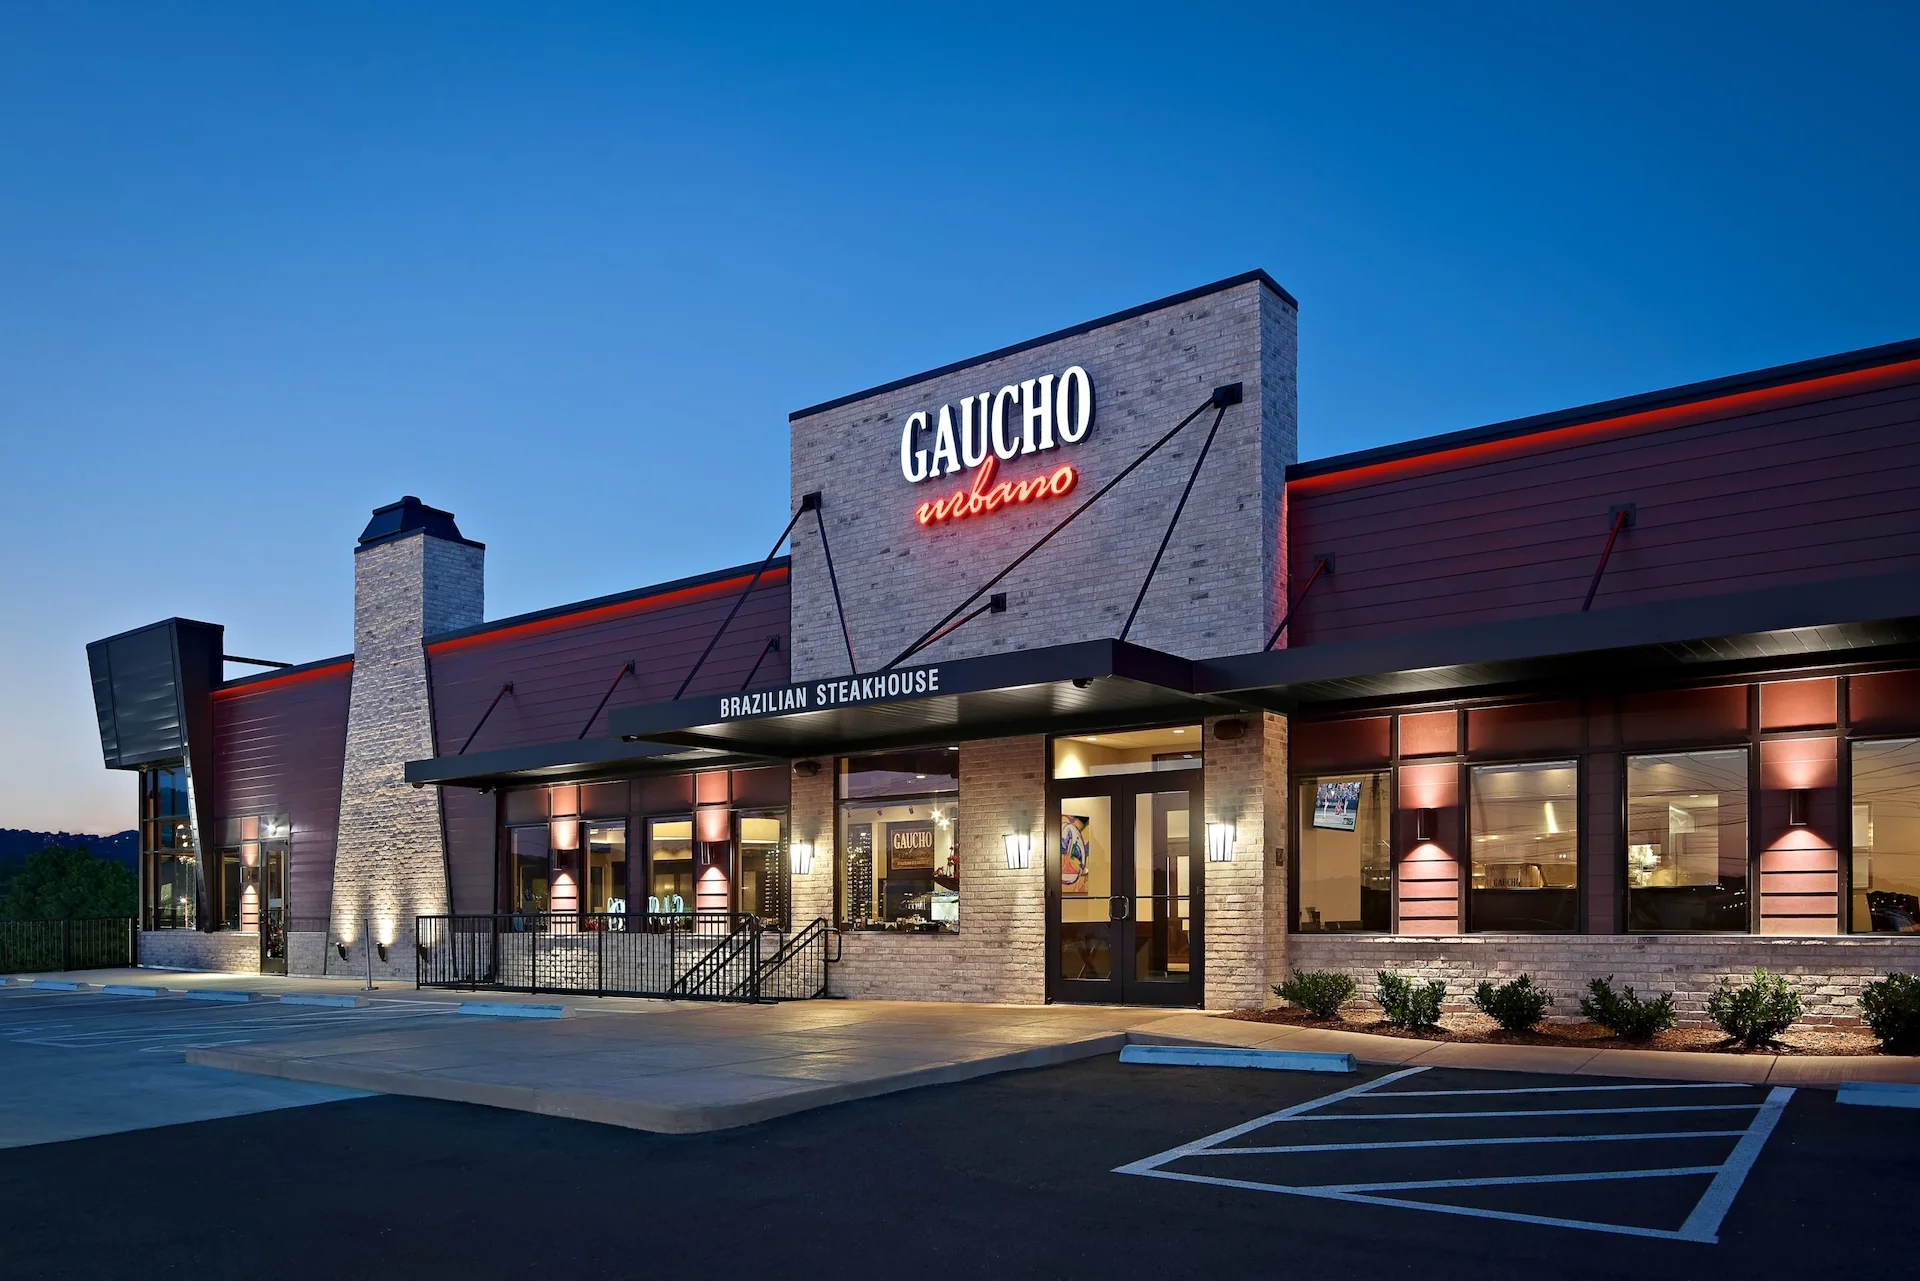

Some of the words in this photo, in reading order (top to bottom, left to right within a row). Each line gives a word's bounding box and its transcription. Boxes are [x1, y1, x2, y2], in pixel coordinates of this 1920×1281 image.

[901, 366, 1092, 483] GAUCHO
[916, 455, 1076, 525] urbano
[720, 687, 807, 718] BRAZILIAN
[816, 668, 939, 705] STEAKHOUSE
[893, 831, 932, 849] GAUCHO
